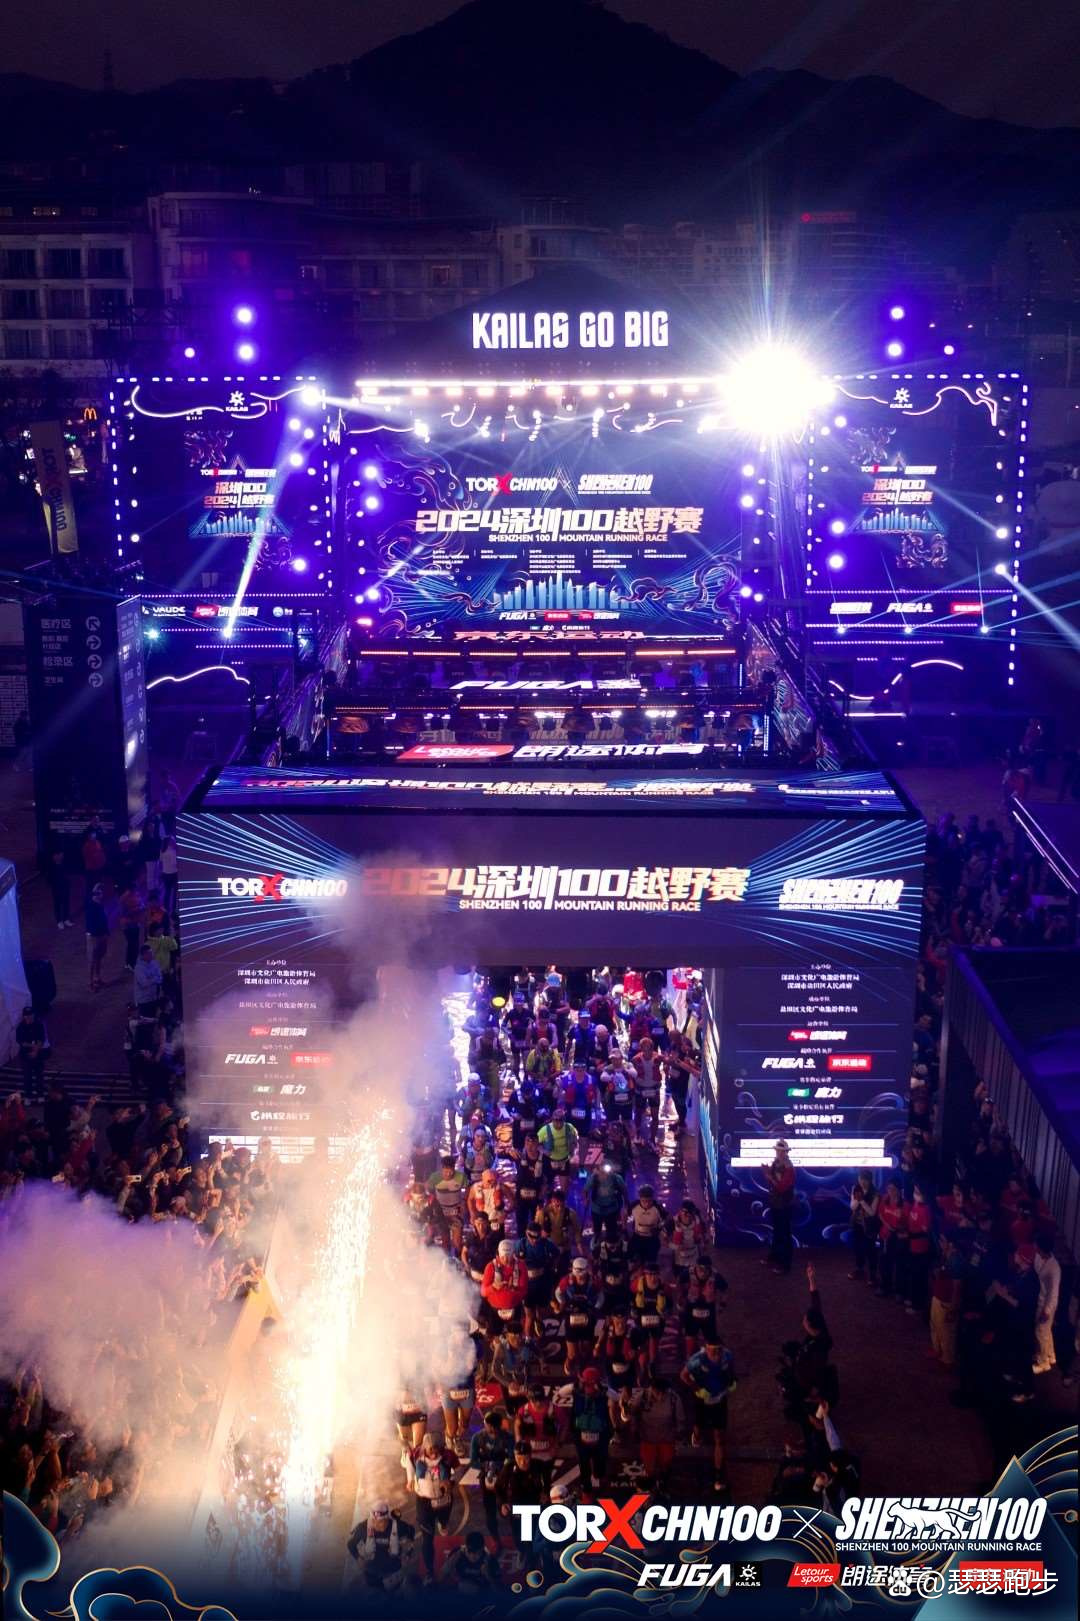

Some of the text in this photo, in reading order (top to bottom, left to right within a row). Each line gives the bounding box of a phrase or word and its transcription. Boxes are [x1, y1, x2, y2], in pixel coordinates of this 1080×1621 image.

[472, 310, 669, 349] KAILAS GO BIG
[415, 507, 704, 541] 2024深圳100越野赛
[488, 534, 668, 542] SHENZHEN 100 MOUNTAIN RUNNING RACE
[449, 680, 594, 690] FUGA
[361, 865, 751, 910] 2024深圳100越野赛
[459, 899, 701, 911] SHENZHEN 100 MOUNTAIN RUNNING RACE
[225, 1054, 266, 1065] FUGA
[762, 1058, 804, 1069] FUGA
